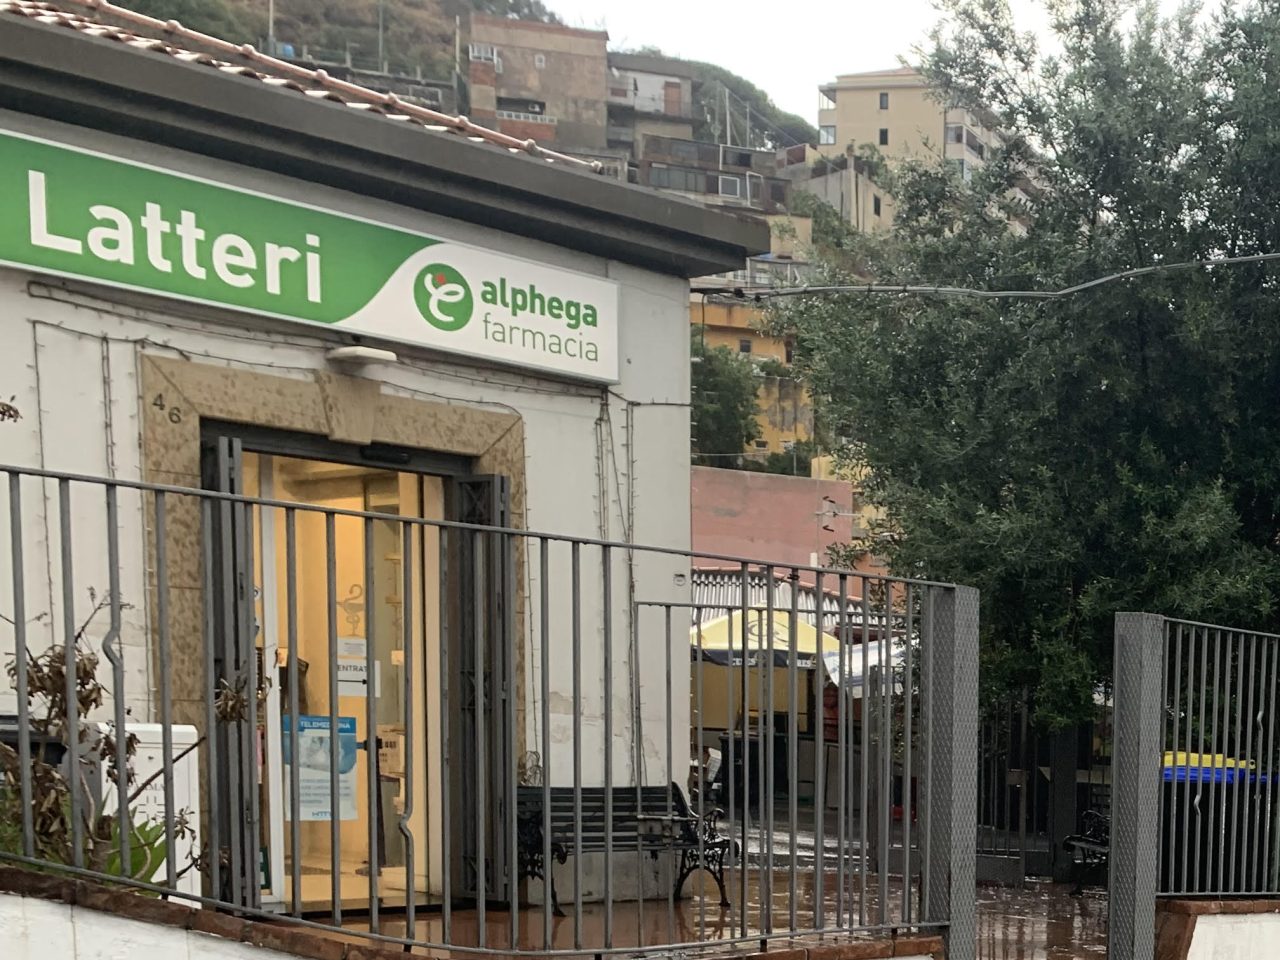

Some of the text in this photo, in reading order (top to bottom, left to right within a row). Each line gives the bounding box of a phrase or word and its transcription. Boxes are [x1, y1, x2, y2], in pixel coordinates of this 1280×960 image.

[28, 169, 321, 303] Latteri
[480, 277, 598, 330] alphega
[482, 312, 599, 362] farmacia
[337, 664, 370, 673] ENTRAT
